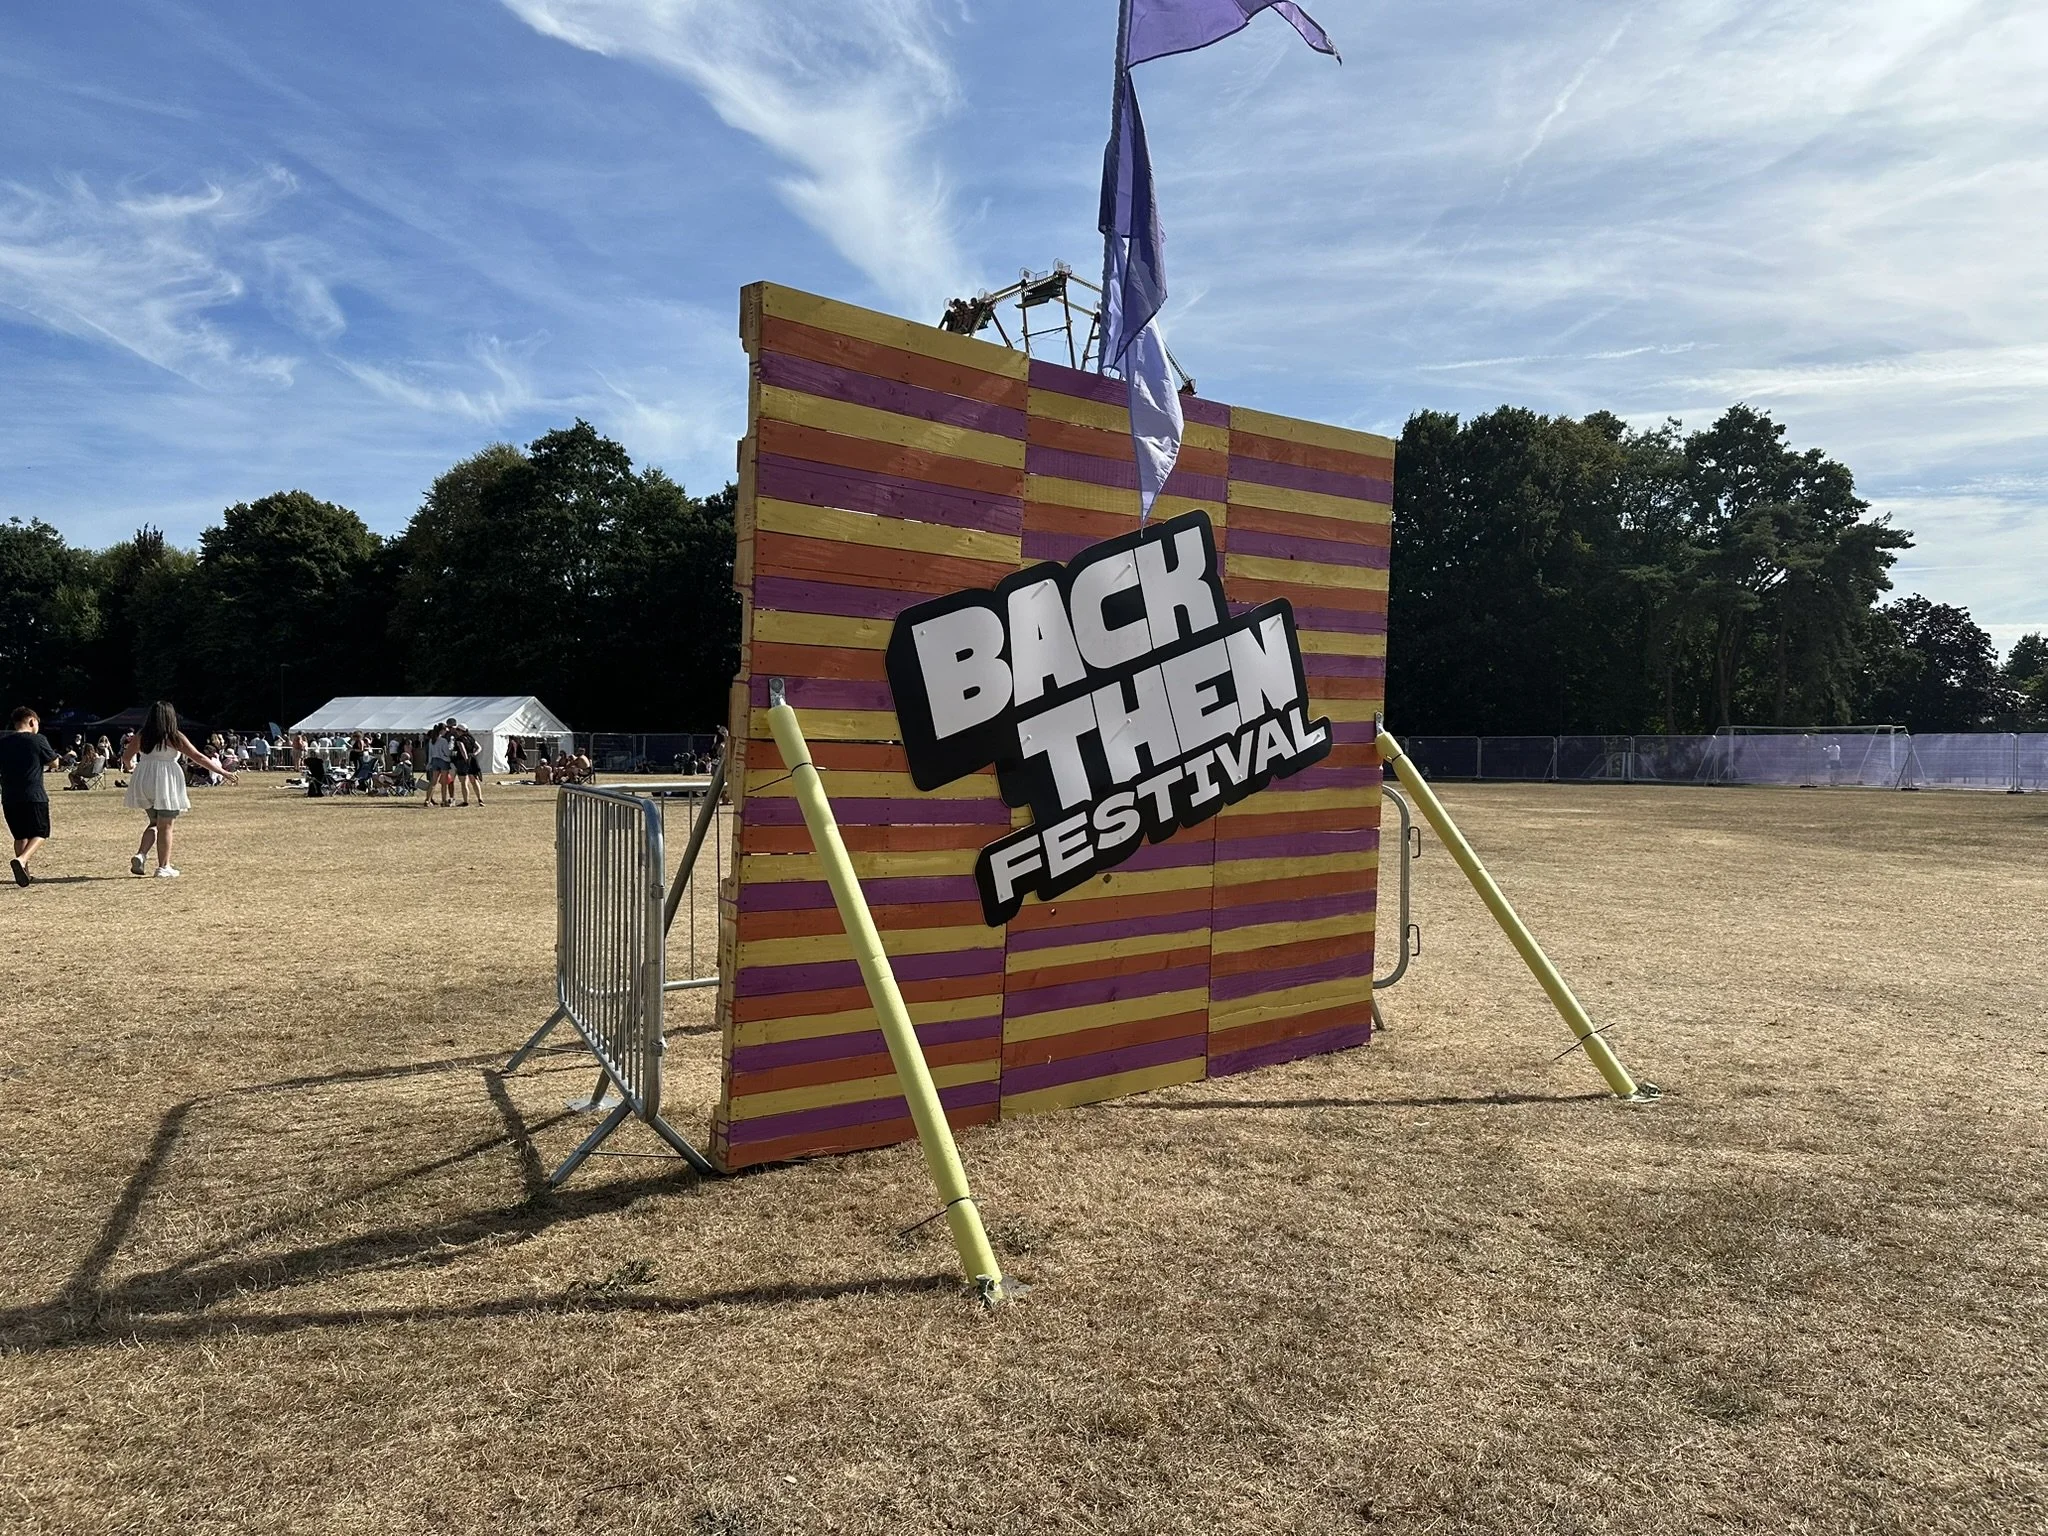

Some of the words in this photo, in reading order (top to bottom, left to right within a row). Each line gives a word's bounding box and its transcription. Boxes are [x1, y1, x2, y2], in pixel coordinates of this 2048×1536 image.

[911, 526, 1219, 740] BACK
[1016, 613, 1298, 810] THEN
[989, 708, 1327, 904] FESTIVAL
